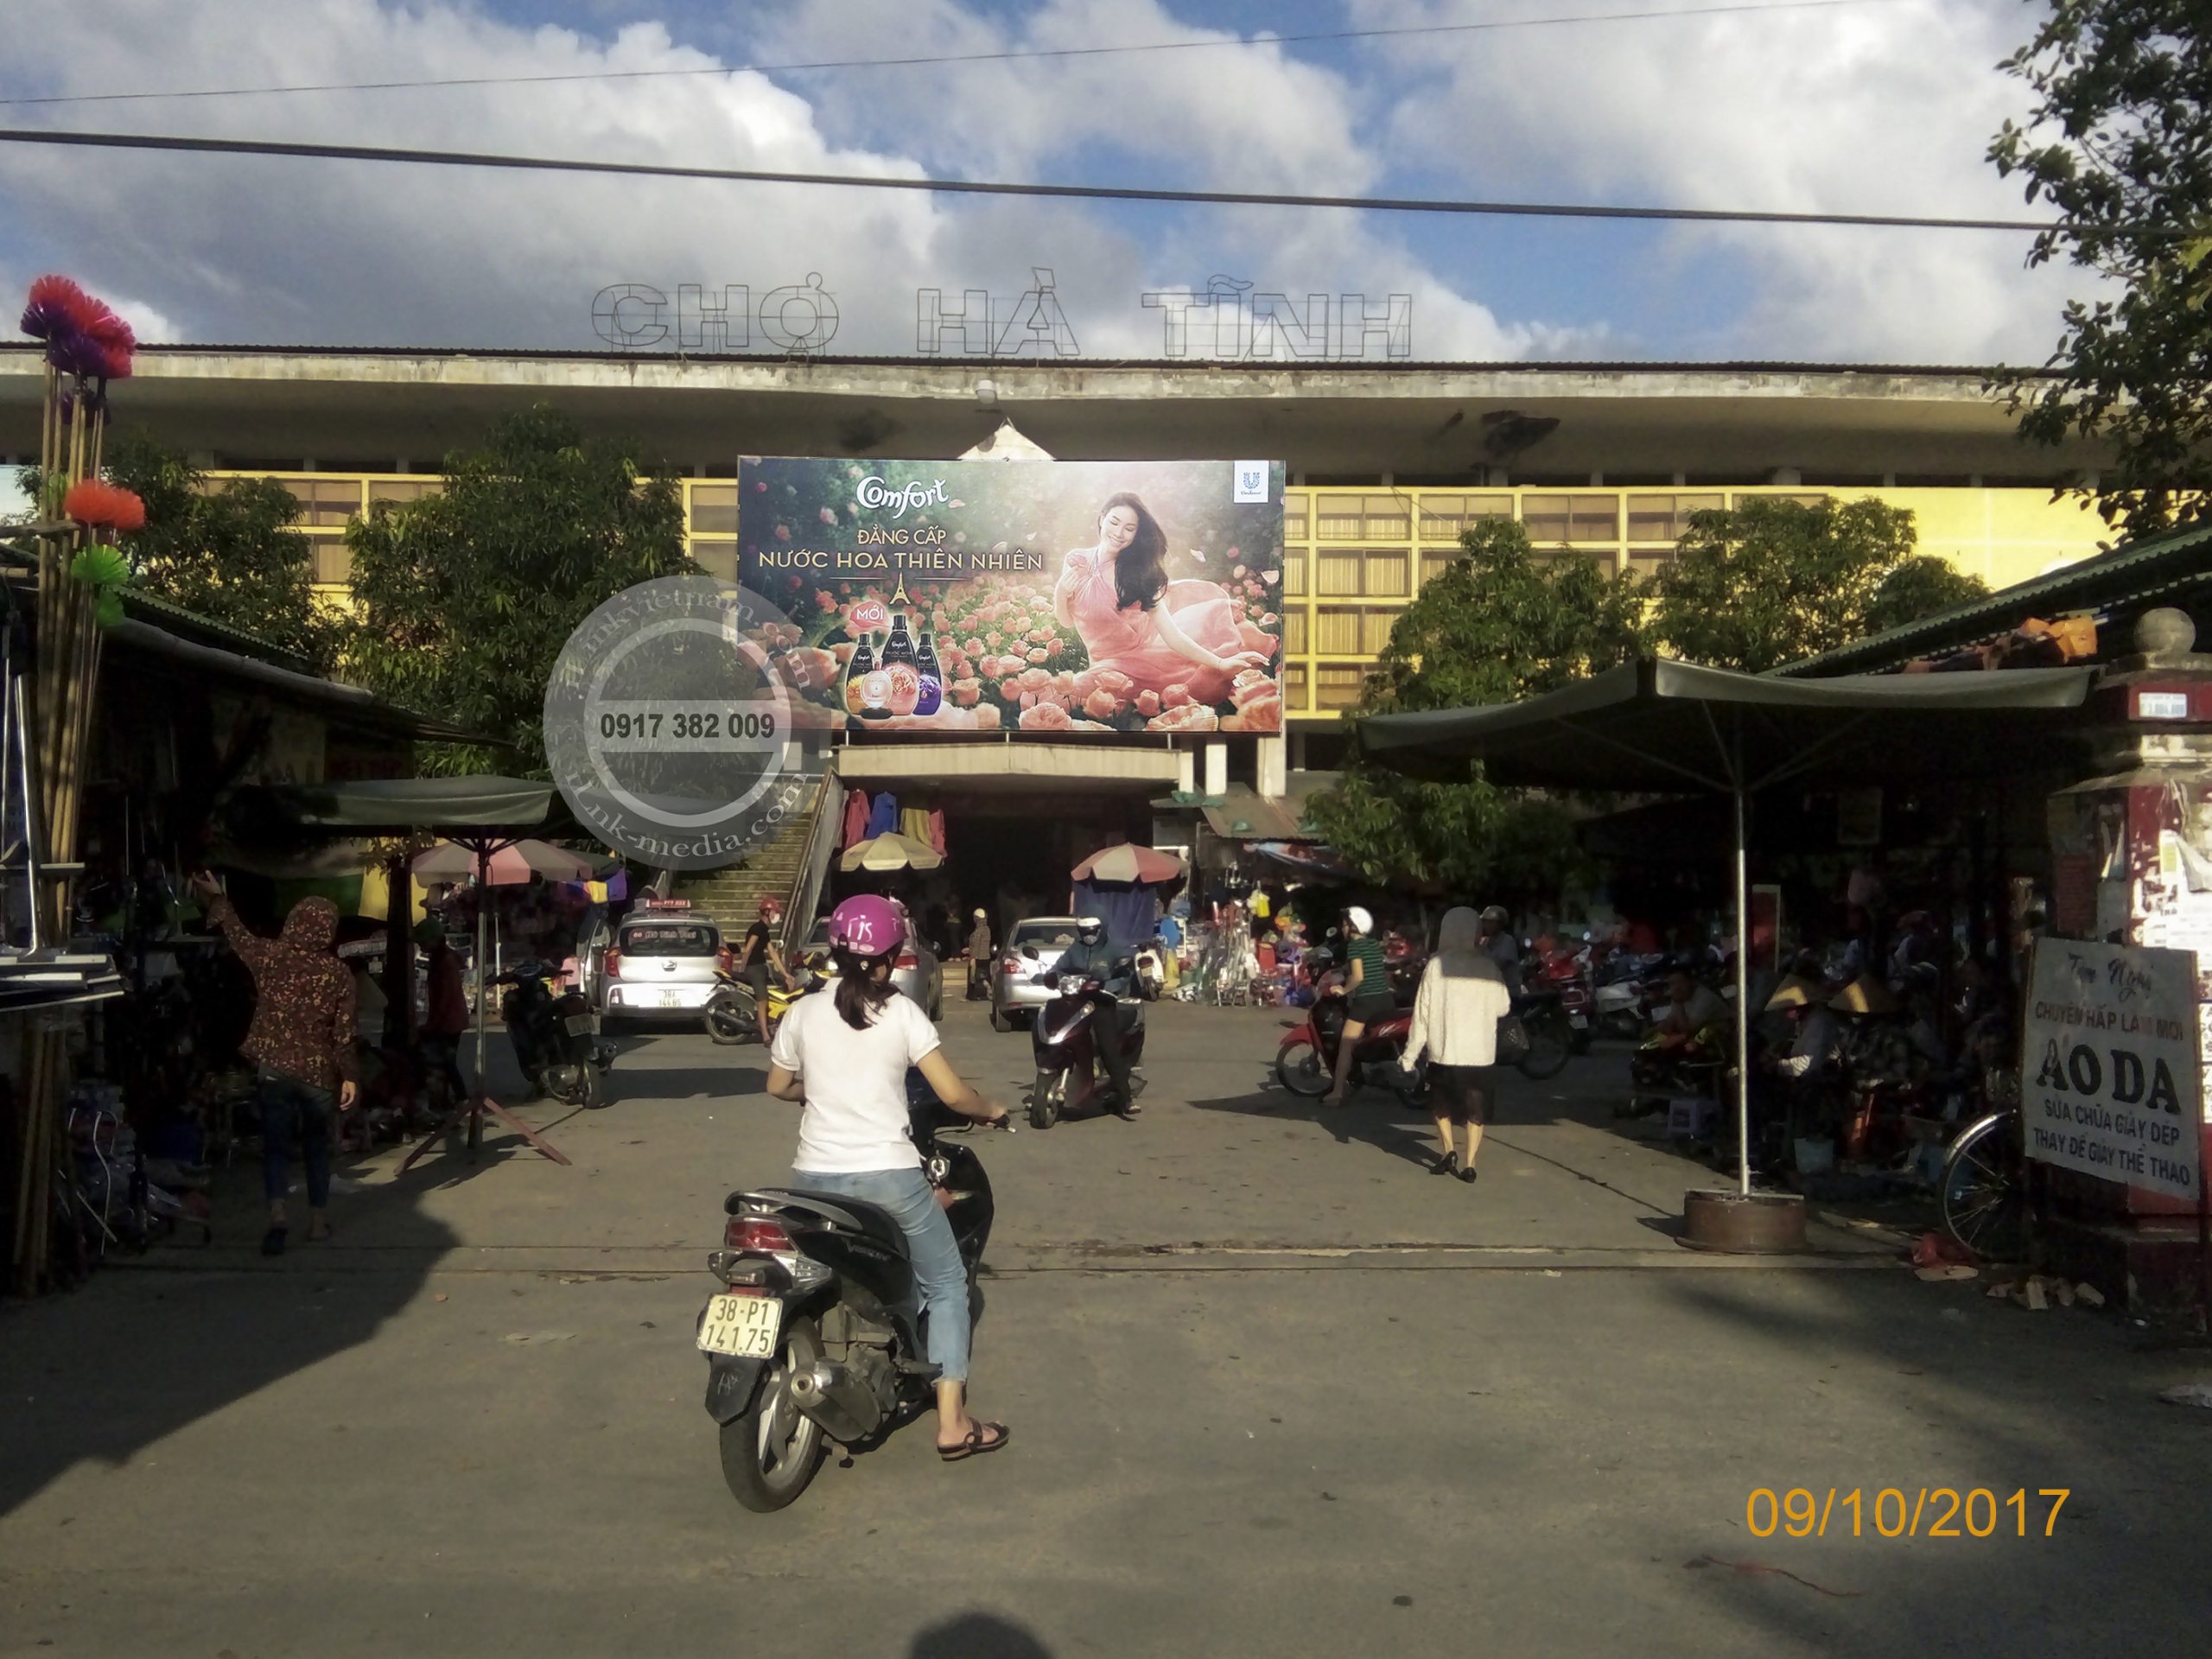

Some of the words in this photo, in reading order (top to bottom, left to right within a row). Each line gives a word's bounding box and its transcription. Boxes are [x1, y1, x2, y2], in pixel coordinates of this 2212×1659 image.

[917, 267, 1080, 356] HÀ
[1141, 274, 1411, 358] TĨNH
[856, 476, 950, 518] Comfort
[912, 524, 947, 545] CẤP
[759, 549, 829, 569] NƯỚC
[836, 552, 888, 569] HOA
[893, 547, 963, 569] THIÊN
[970, 548, 1043, 570] NHIÊN
[855, 605, 884, 620] MỚI
[2110, 1048, 2182, 1115] DA
[2033, 1127, 2066, 1153] THAY
[2149, 1157, 2191, 1185] THAO
[715, 1298, 770, 1325] 38-P1
[706, 1324, 772, 1353] 141.75
